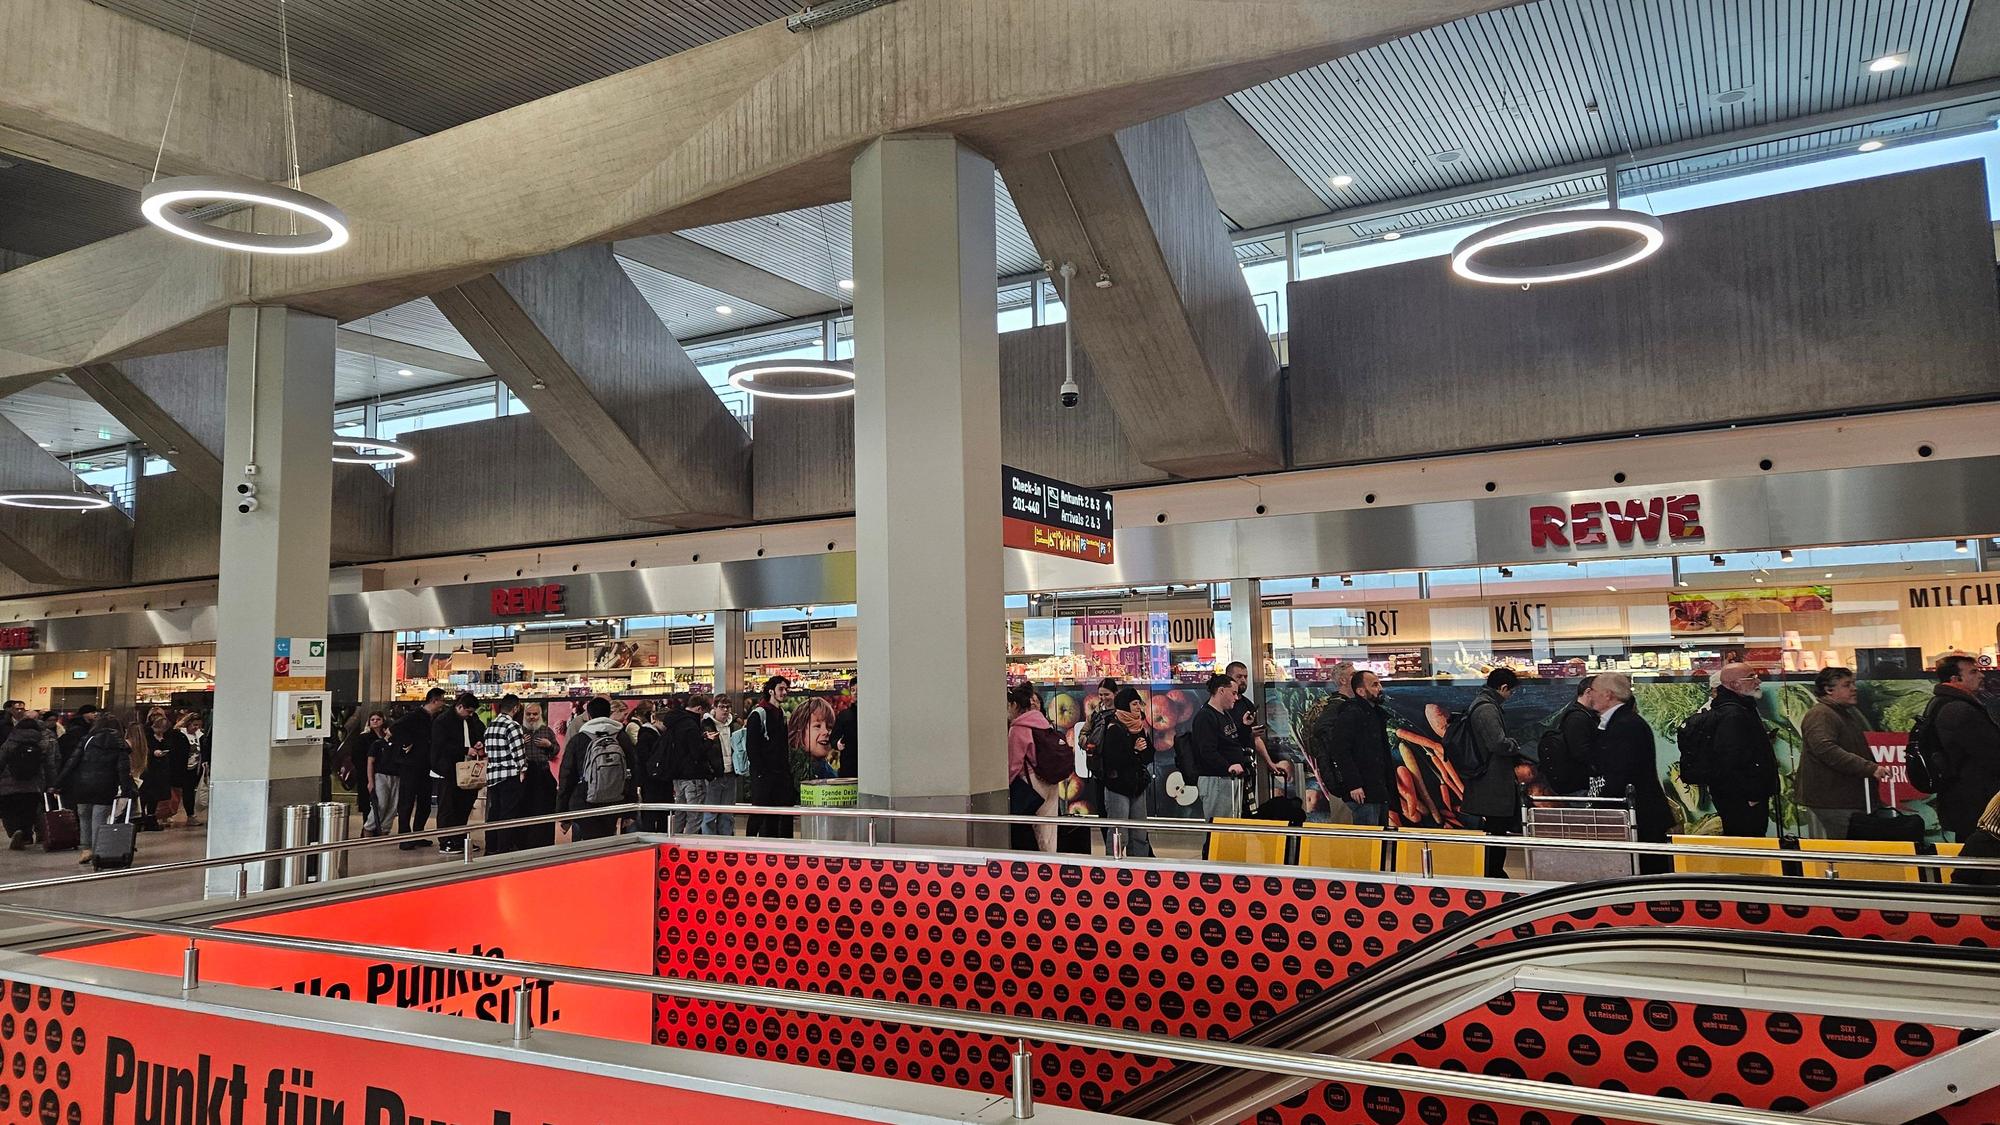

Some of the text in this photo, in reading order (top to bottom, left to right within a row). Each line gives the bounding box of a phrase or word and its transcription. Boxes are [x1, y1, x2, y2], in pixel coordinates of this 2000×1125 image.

[1012, 477, 1042, 496] Check-in
[1012, 496, 1040, 514] 201-440
[1061, 490, 1100, 511] Ankunft 2 & 3
[1061, 509, 1101, 530] Arrivals 2 & 3
[1530, 494, 1704, 547] REWE
[491, 583, 562, 615] REWE
[1495, 601, 1548, 632] KÄSE
[367, 944, 504, 1008] Punkte
[1826, 1034, 1872, 1044] versteht Sie.
[1840, 1025, 1856, 1033] SIXT
[103, 1036, 247, 1125] Punkt
